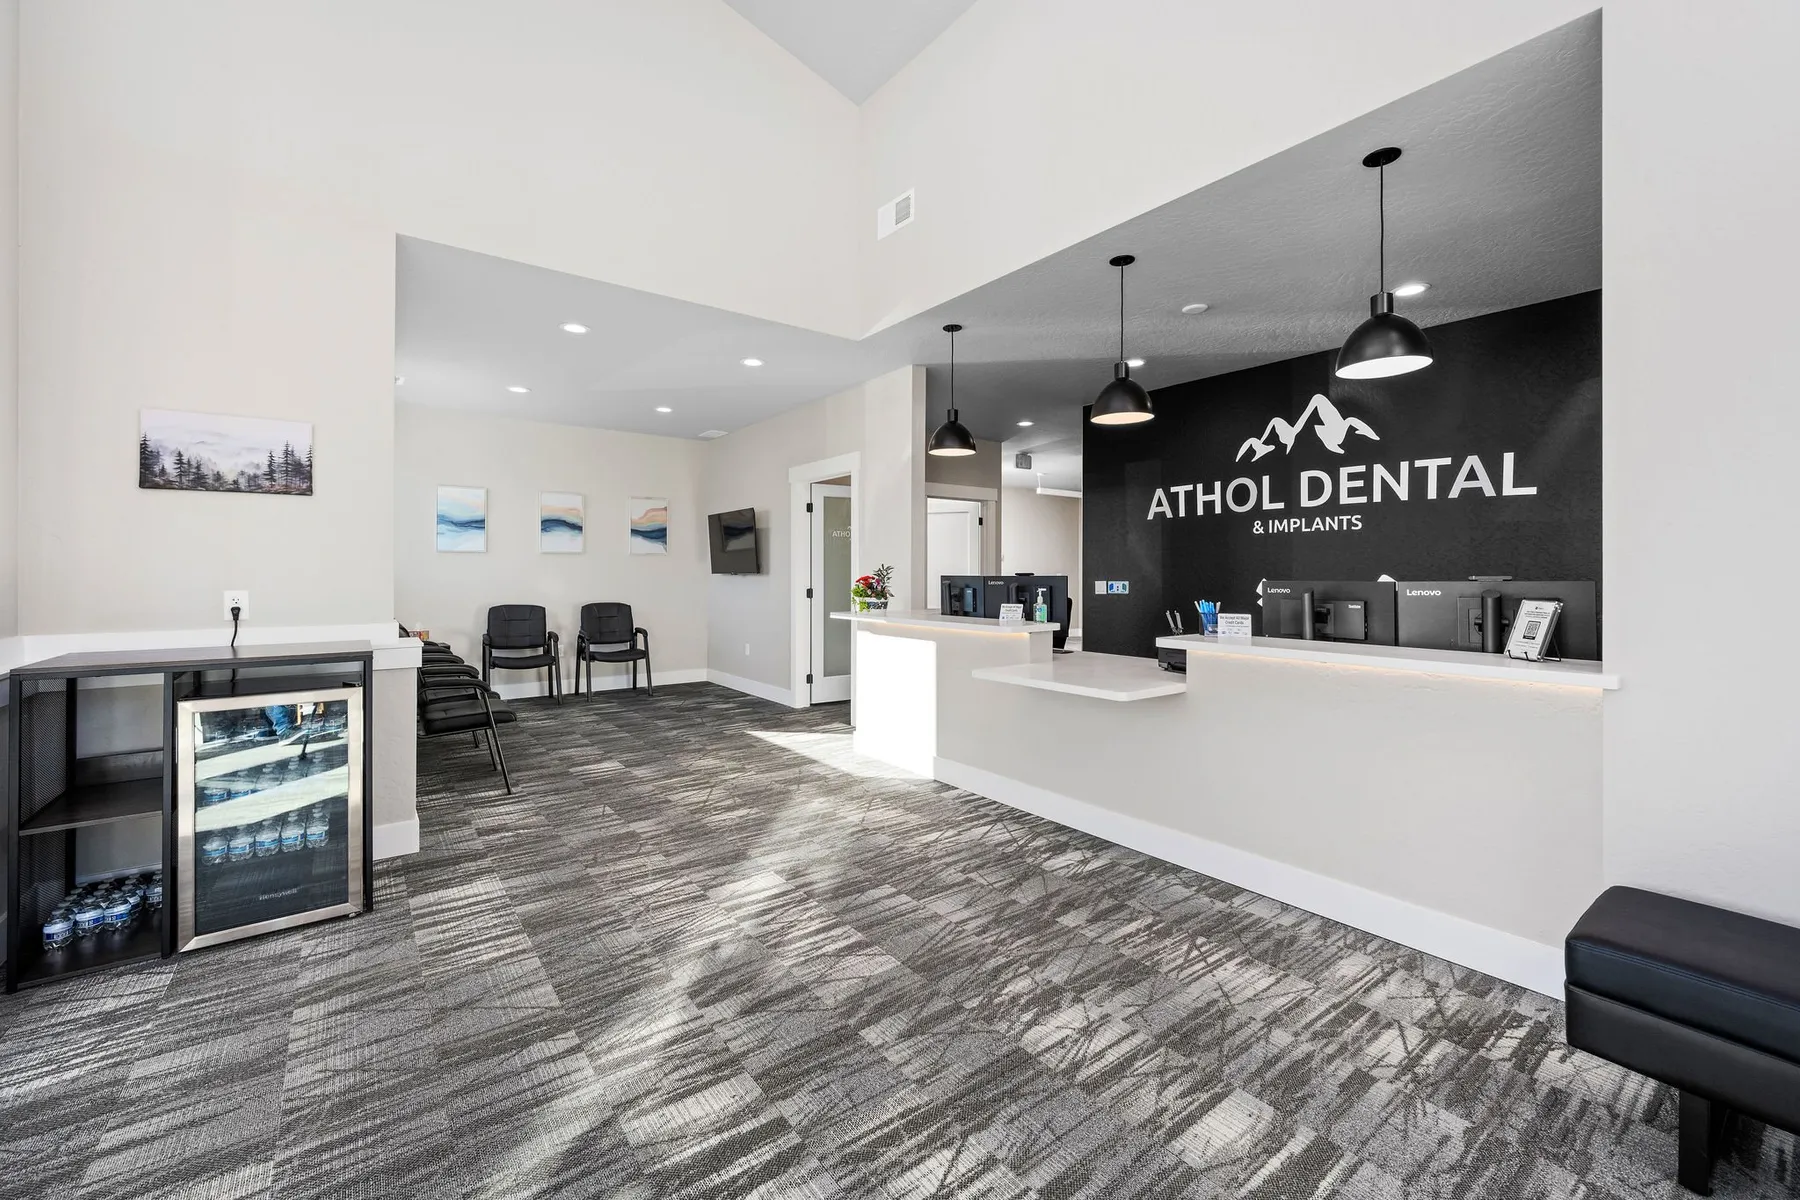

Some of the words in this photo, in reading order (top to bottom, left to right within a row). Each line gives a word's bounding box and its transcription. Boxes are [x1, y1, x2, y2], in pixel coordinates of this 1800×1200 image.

[1147, 475, 1285, 520] ATHOL
[1300, 452, 1538, 508] DENTAL
[832, 530, 851, 538] ATHO
[1252, 520, 1265, 535] &
[1268, 514, 1363, 534] IMPLANTS
